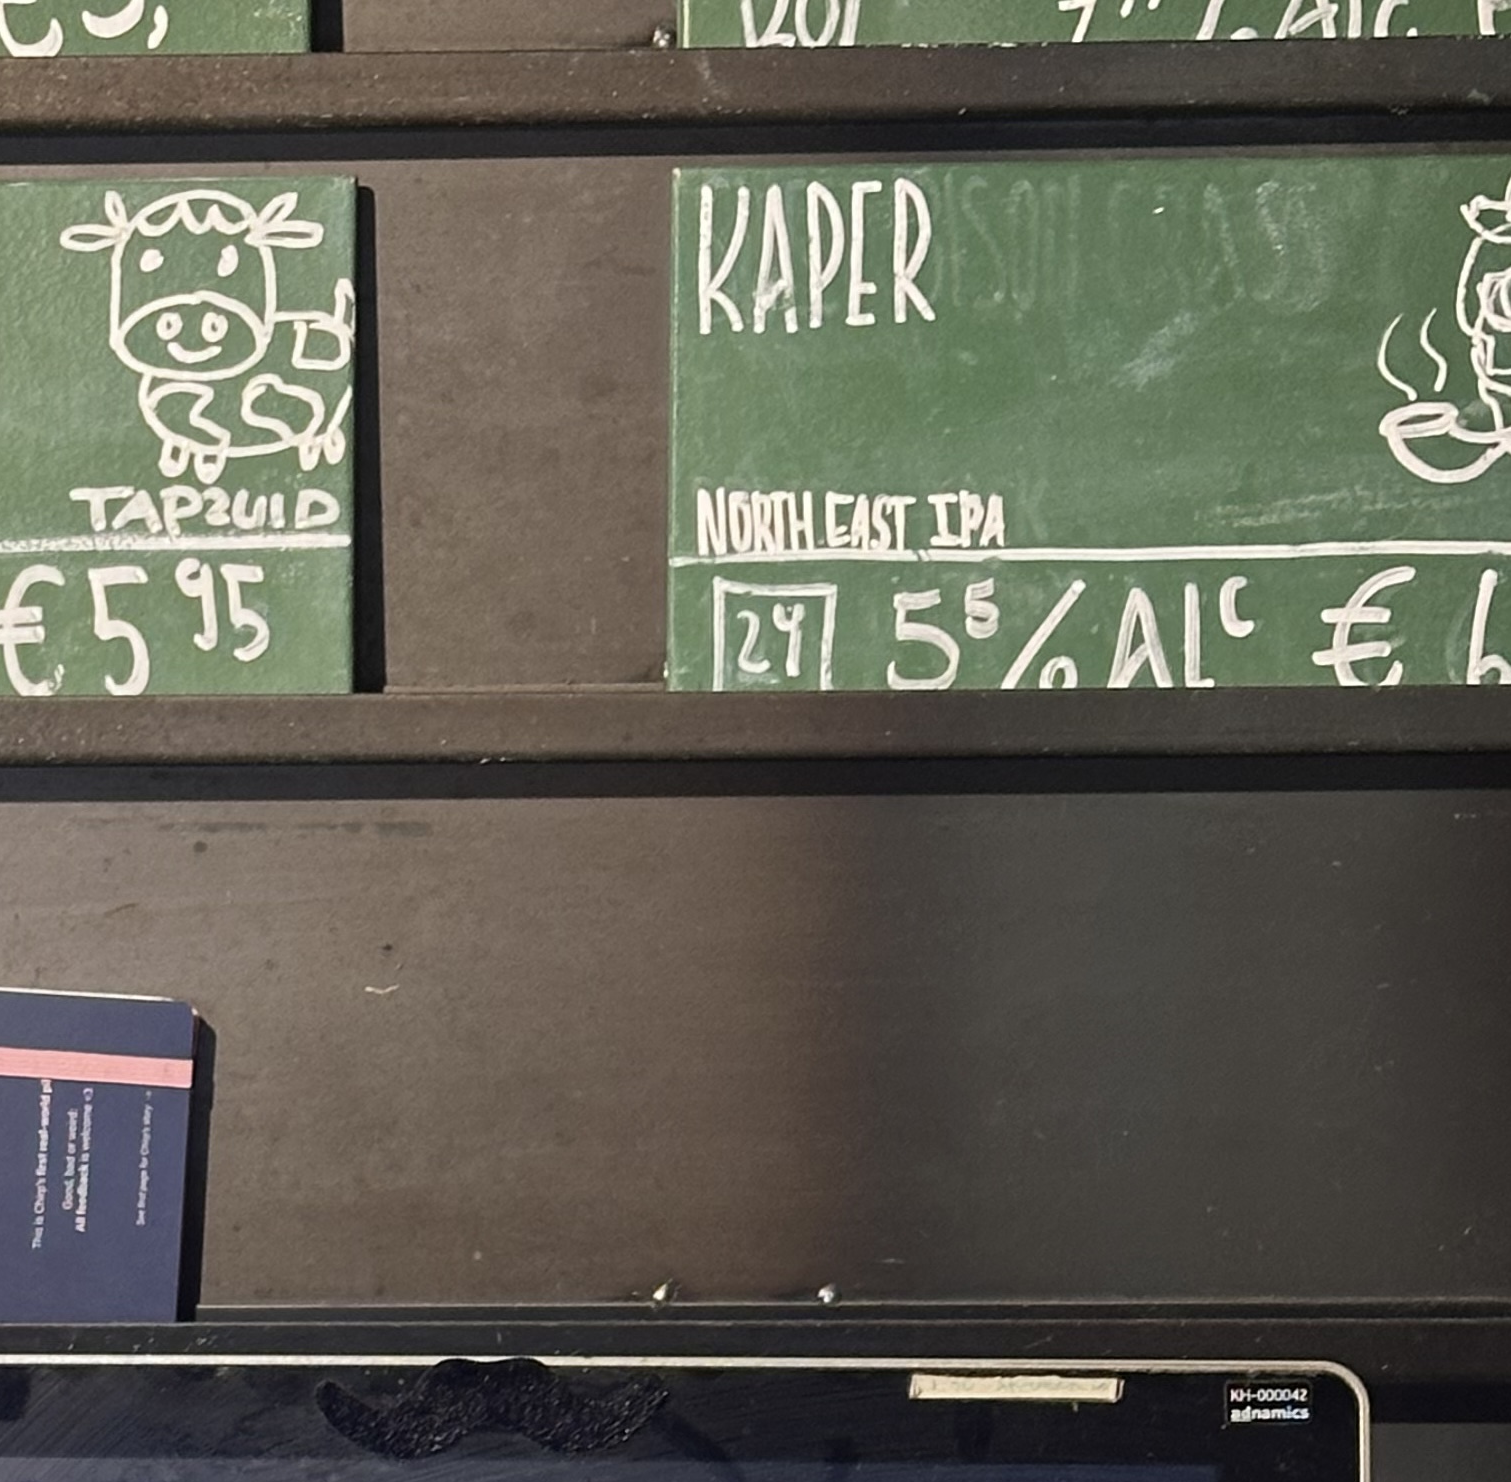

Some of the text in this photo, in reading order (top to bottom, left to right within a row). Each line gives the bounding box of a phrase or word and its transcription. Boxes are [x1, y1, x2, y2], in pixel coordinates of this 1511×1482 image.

[699, 176, 936, 334] KAPER
[697, 487, 1006, 556] NORTH EAST IPA
[736, 603, 804, 677] 24
[75, 1218, 86, 1232] All
[1230, 1406, 1310, 1423] adnamics
